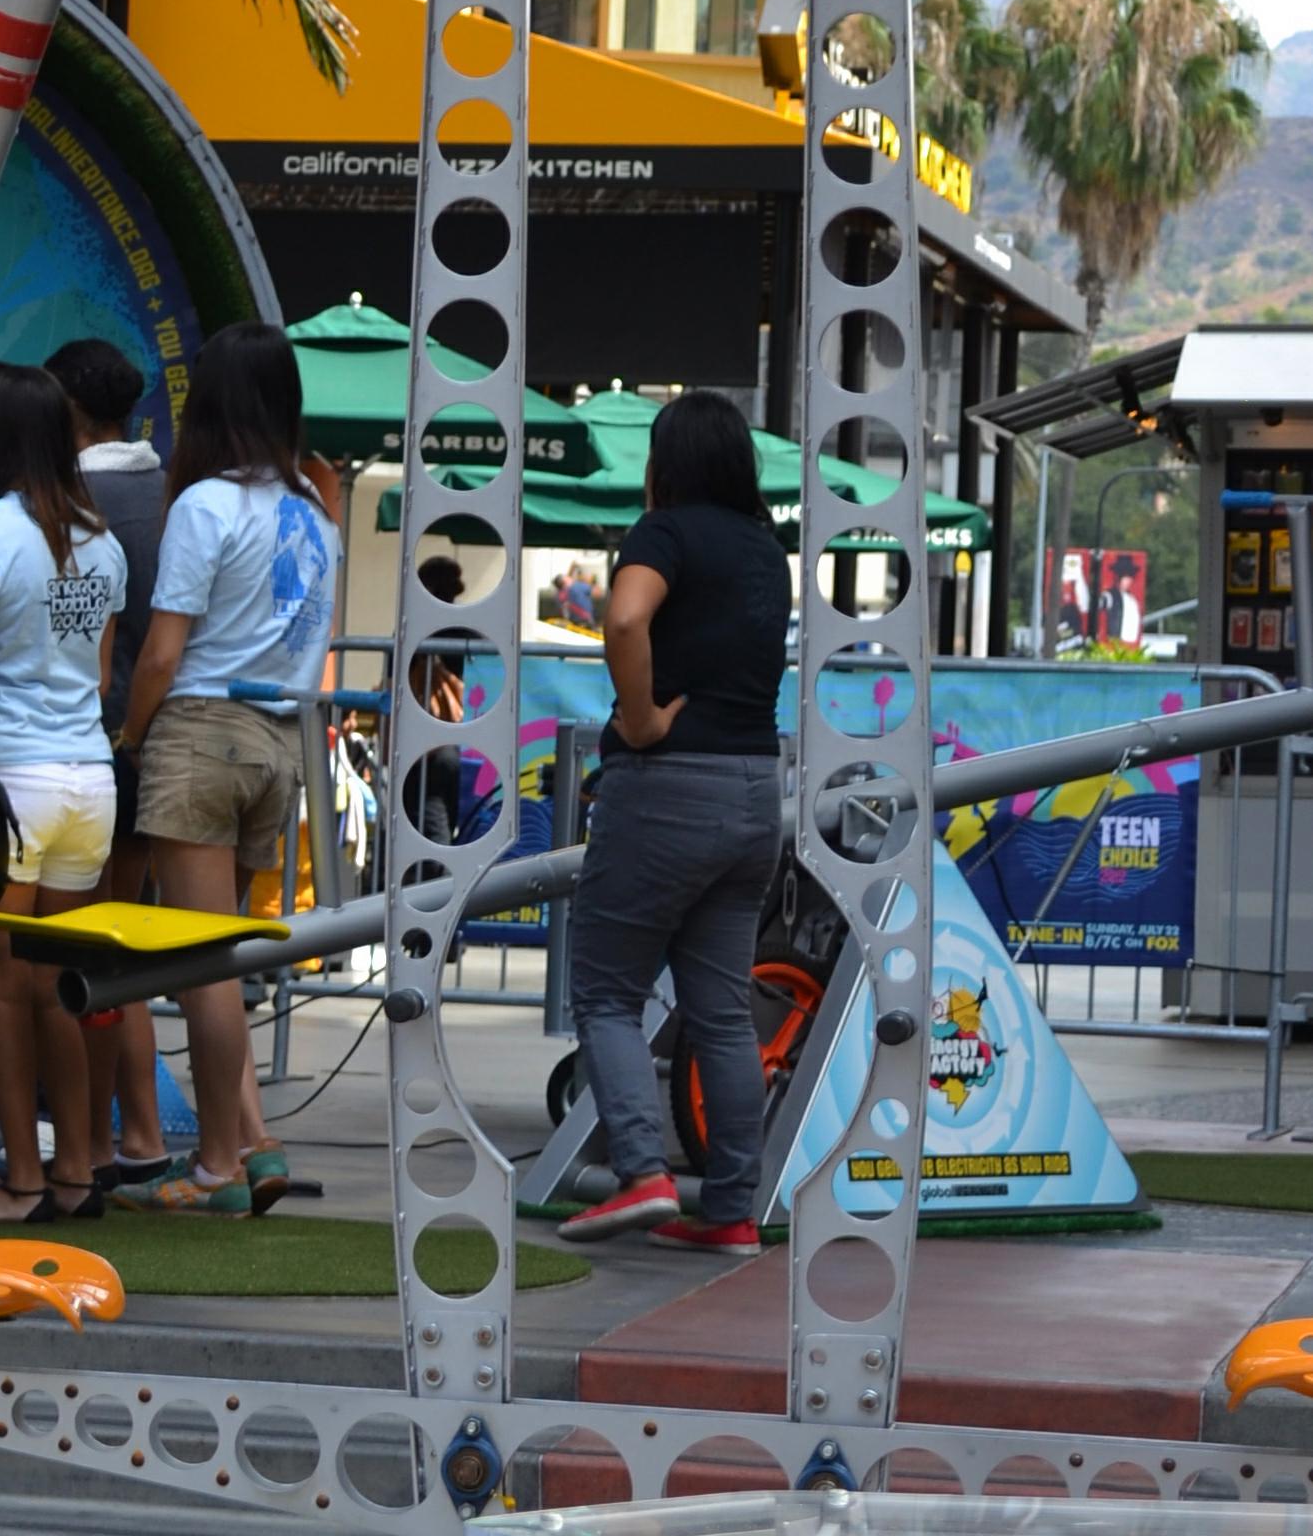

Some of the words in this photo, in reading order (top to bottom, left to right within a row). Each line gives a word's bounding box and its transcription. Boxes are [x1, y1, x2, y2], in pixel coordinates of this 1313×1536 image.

[284, 151, 418, 175] california
[527, 160, 654, 178] KITCHEN
[383, 432, 565, 460] SARBUKS
[1099, 816, 1161, 846] TEEN
[1146, 937, 1180, 950] FOX
